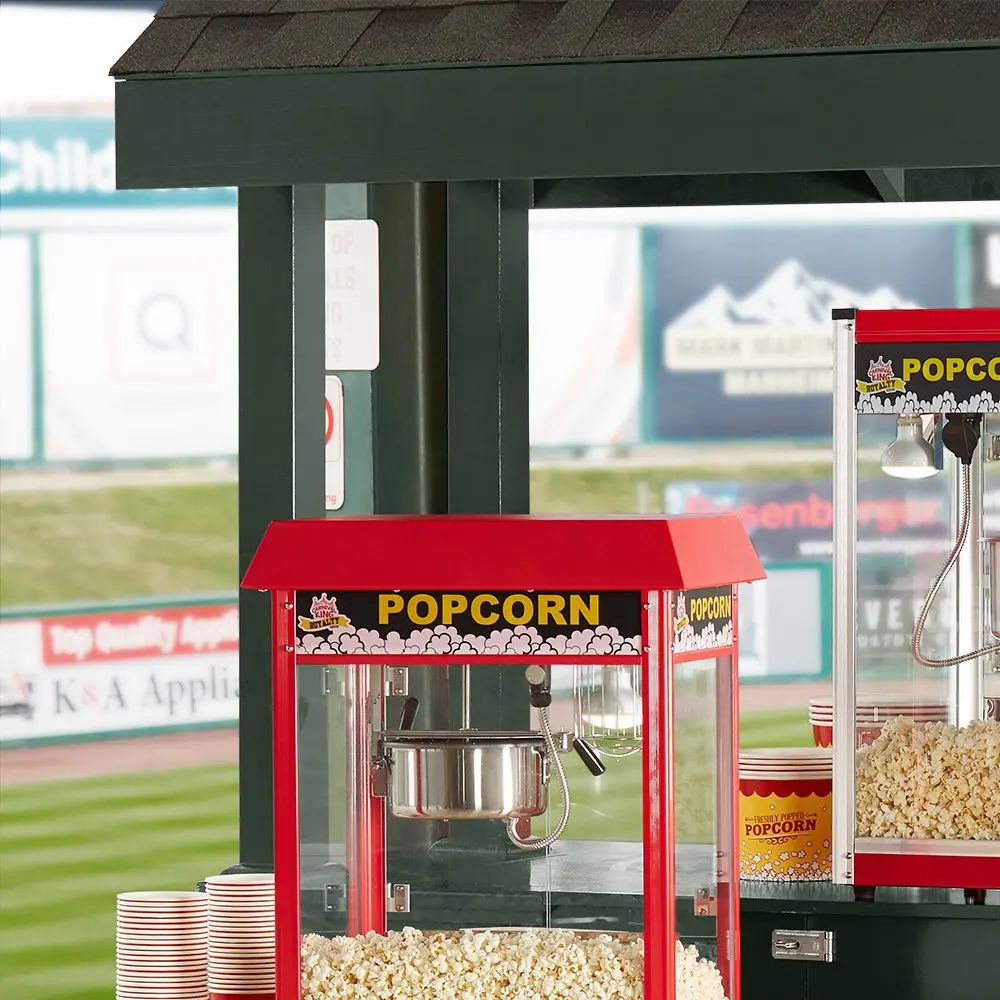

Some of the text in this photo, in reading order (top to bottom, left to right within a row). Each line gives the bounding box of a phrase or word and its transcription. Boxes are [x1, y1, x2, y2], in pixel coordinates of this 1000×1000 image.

[872, 373, 890, 381] KING
[866, 380, 896, 393] ROYALTY
[315, 610, 334, 618] KING
[378, 593, 600, 626] POPCORN
[690, 595, 731, 621] POPCORN
[309, 617, 340, 629] ROYALTY
[780, 812, 805, 821] POPPED
[745, 819, 817, 836] POPCORN
